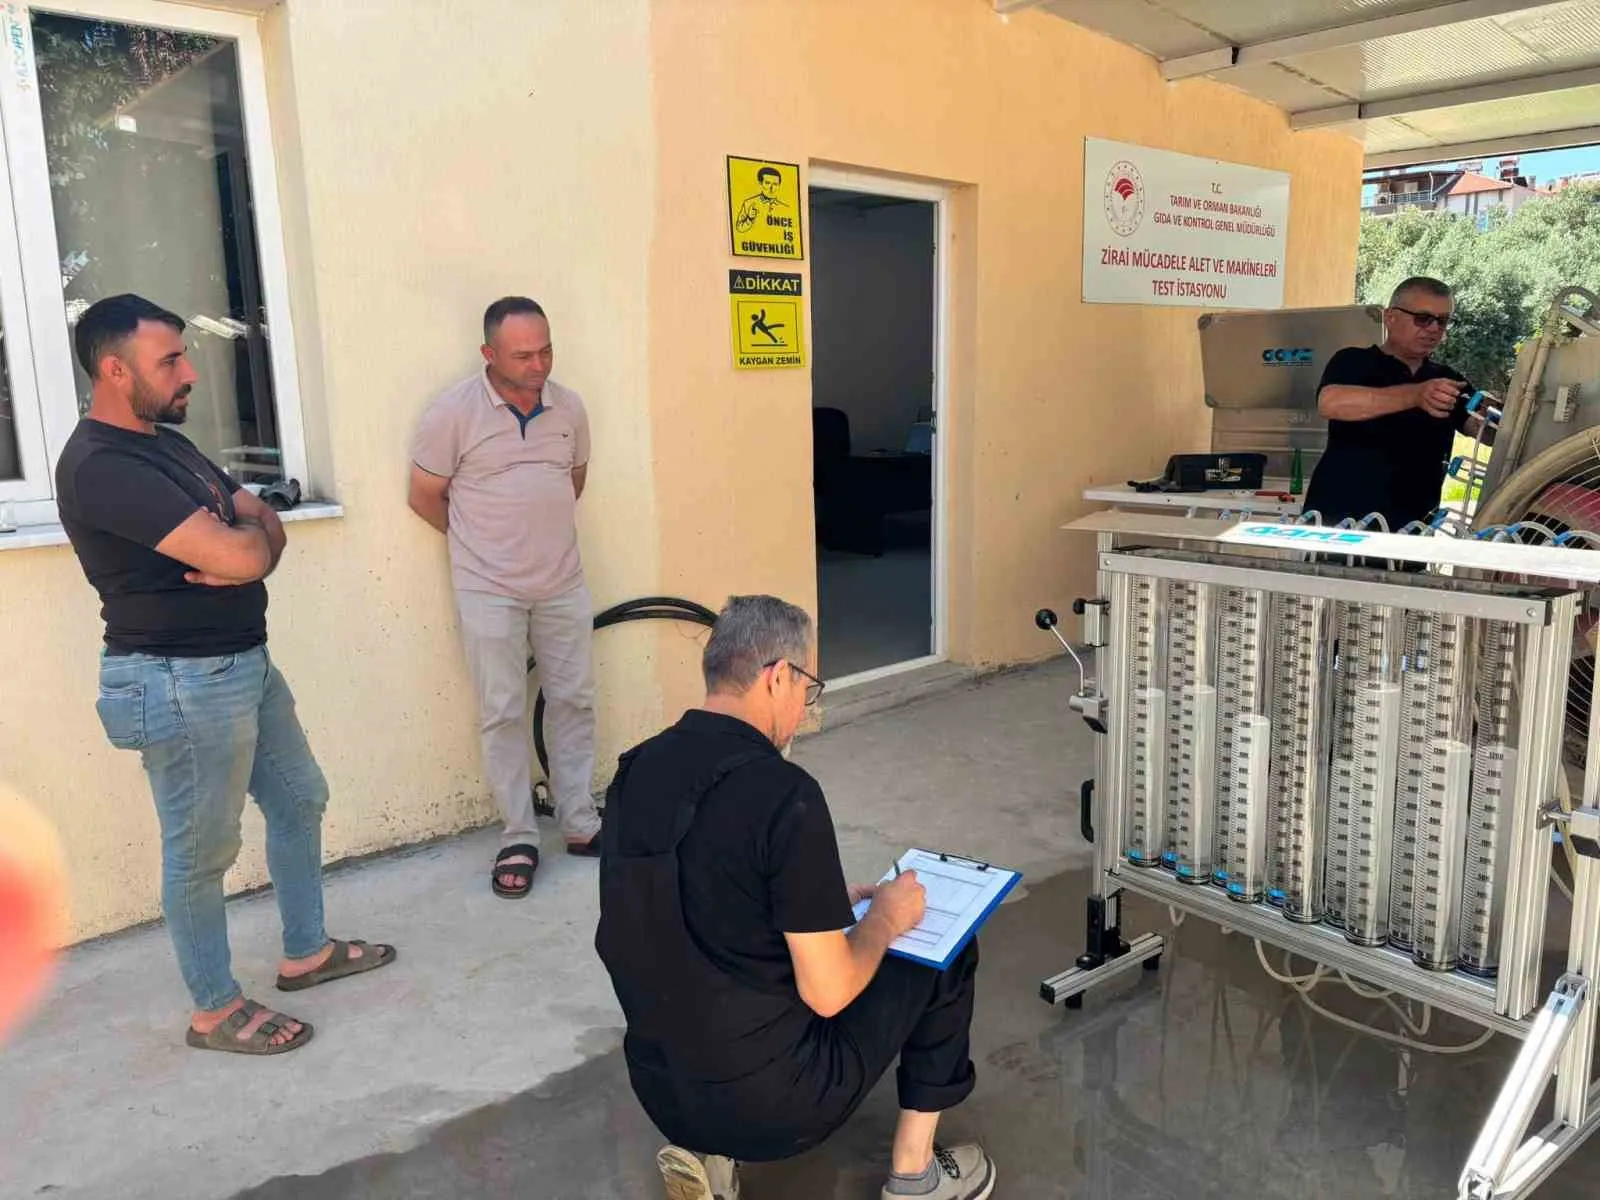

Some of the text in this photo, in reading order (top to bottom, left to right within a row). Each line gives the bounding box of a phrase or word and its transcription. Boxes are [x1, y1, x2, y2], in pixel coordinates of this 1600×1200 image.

[1170, 195, 1262, 218] TARIM VE ORMAN BAKANLIĞI
[767, 213, 793, 228] ÖNCE
[1153, 212, 1276, 238] GIDA VE KONTROL GENEL MÜDÜRLÜĞÜ
[1101, 245, 1277, 278] ZİRAİ MÜCADELE ALET VE MAKİNELERİ
[745, 274, 800, 292] DİKKAT
[1152, 277, 1227, 299] TEST İSTASYONU
[739, 354, 801, 366] KAYGAN ZEMİN
